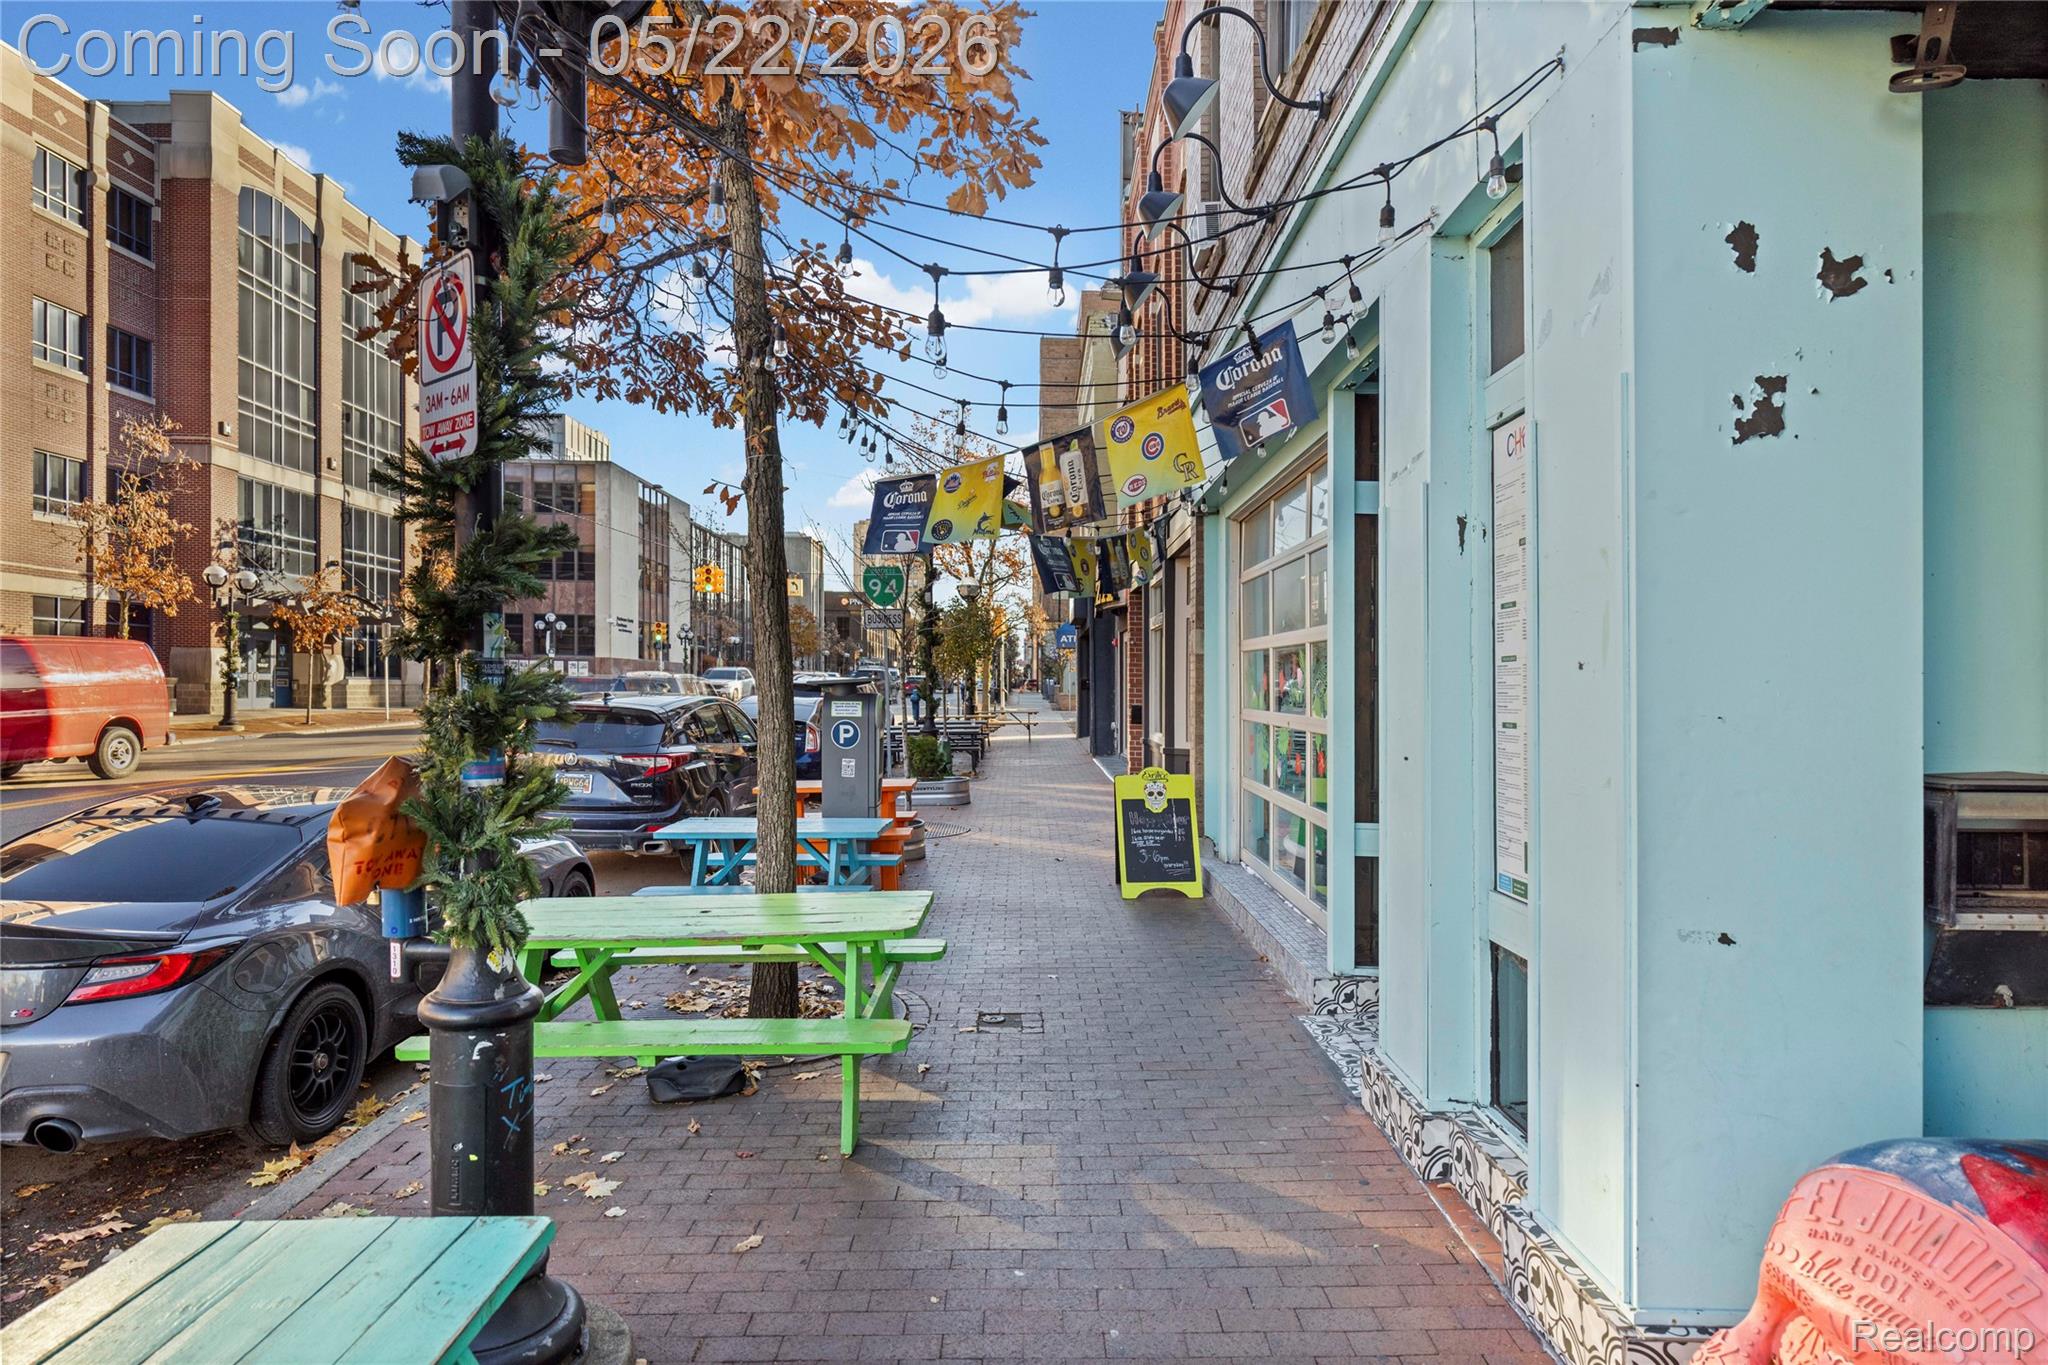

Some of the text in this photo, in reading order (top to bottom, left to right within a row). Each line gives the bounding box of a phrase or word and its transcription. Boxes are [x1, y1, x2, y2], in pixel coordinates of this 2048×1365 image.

[1216, 347, 1284, 391] Corona
[422, 412, 474, 440] TOW AWAY ZONE
[1067, 459, 1080, 504] Corona
[883, 490, 928, 510] Corona
[868, 578, 898, 598] 94
[867, 613, 903, 625] BUSINESS
[839, 724, 855, 744] P
[1805, 1177, 1850, 1227] EL
[1856, 1190, 2042, 1325] JIMADOR
[1807, 1226, 1857, 1248] HAND
[1864, 1242, 1974, 1323] HARVESTED
